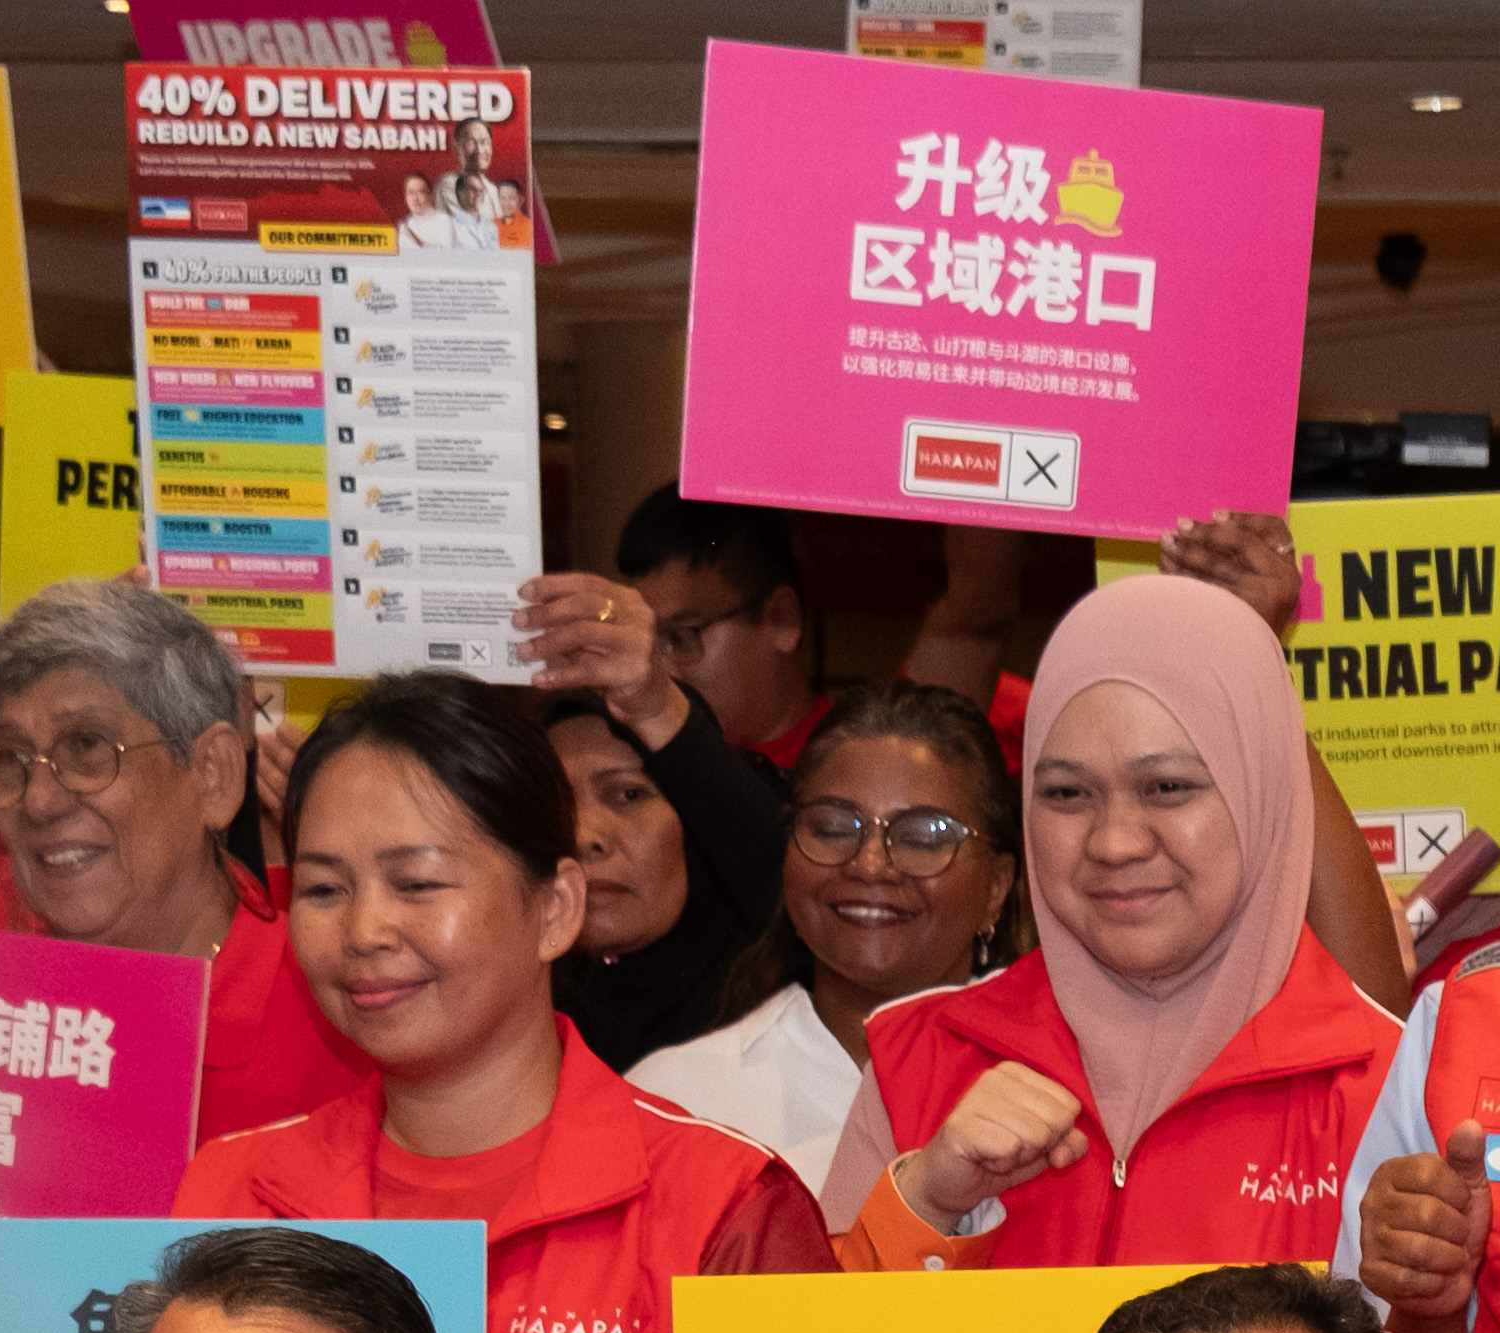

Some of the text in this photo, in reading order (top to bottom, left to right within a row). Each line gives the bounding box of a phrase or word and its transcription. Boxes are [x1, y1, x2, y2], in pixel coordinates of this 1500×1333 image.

[178, 18, 399, 68] UPGRADE
[137, 74, 513, 122] 40% DELIVERED
[138, 119, 447, 151] REBUILD A NEW SABAH!
[896, 133, 1051, 226] 升级
[850, 222, 1156, 331] 区域港口
[918, 451, 996, 471] HARAPAN
[1342, 546, 1495, 621] NEW
[1327, 725, 1399, 741] industrial
[1403, 721, 1446, 739] parks
[1451, 719, 1466, 735] to
[1327, 746, 1388, 762] support
[1392, 743, 1489, 758] downstream
